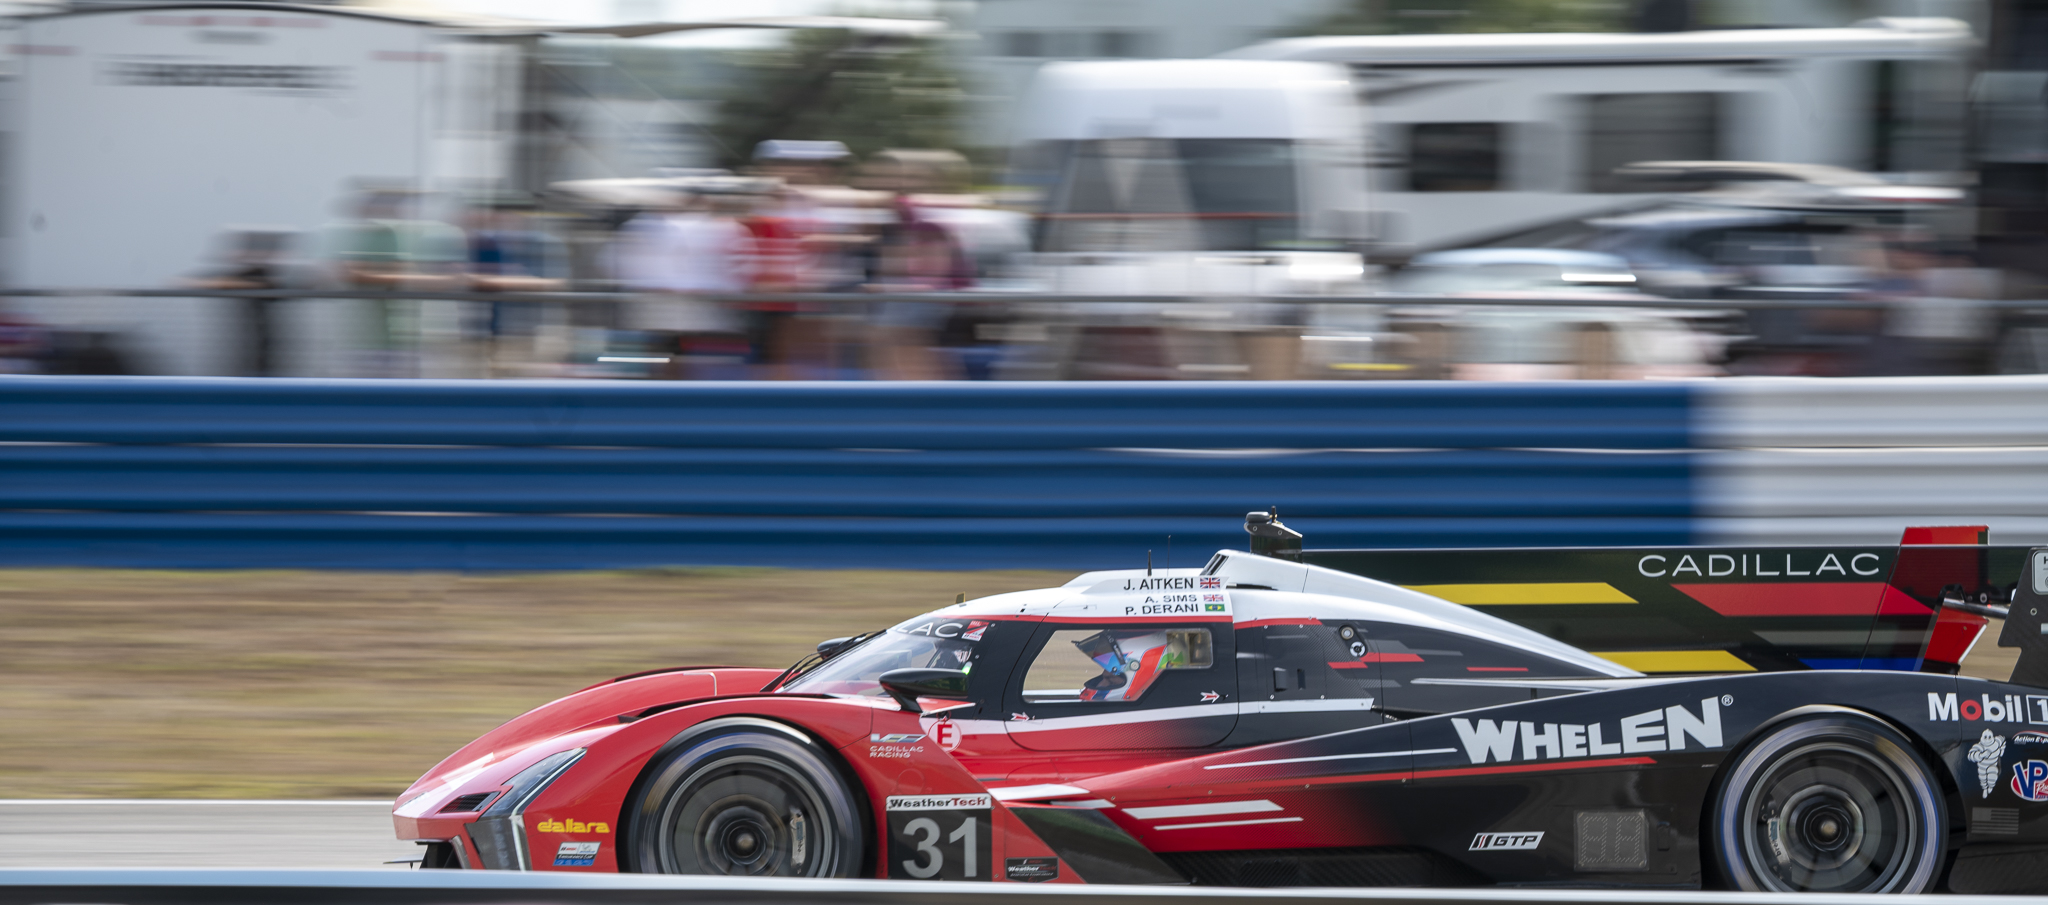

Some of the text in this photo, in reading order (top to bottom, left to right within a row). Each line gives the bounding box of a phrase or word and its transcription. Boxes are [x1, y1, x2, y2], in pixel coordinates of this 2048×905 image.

[1637, 552, 1880, 577] CADILLAC
[1123, 577, 1194, 591] J. AITKEN
[1144, 594, 1198, 604] A. SIMS
[1125, 603, 1199, 615] P. DERANI
[1927, 692, 2023, 723] Mobil
[937, 724, 953, 748] E
[1450, 696, 1724, 765] WHELEN
[2012, 759, 2048, 800] VP
[890, 797, 986, 808] WeatherTech
[537, 818, 610, 833] dallara
[902, 816, 978, 879] 31
[1492, 835, 1539, 847] GTP
